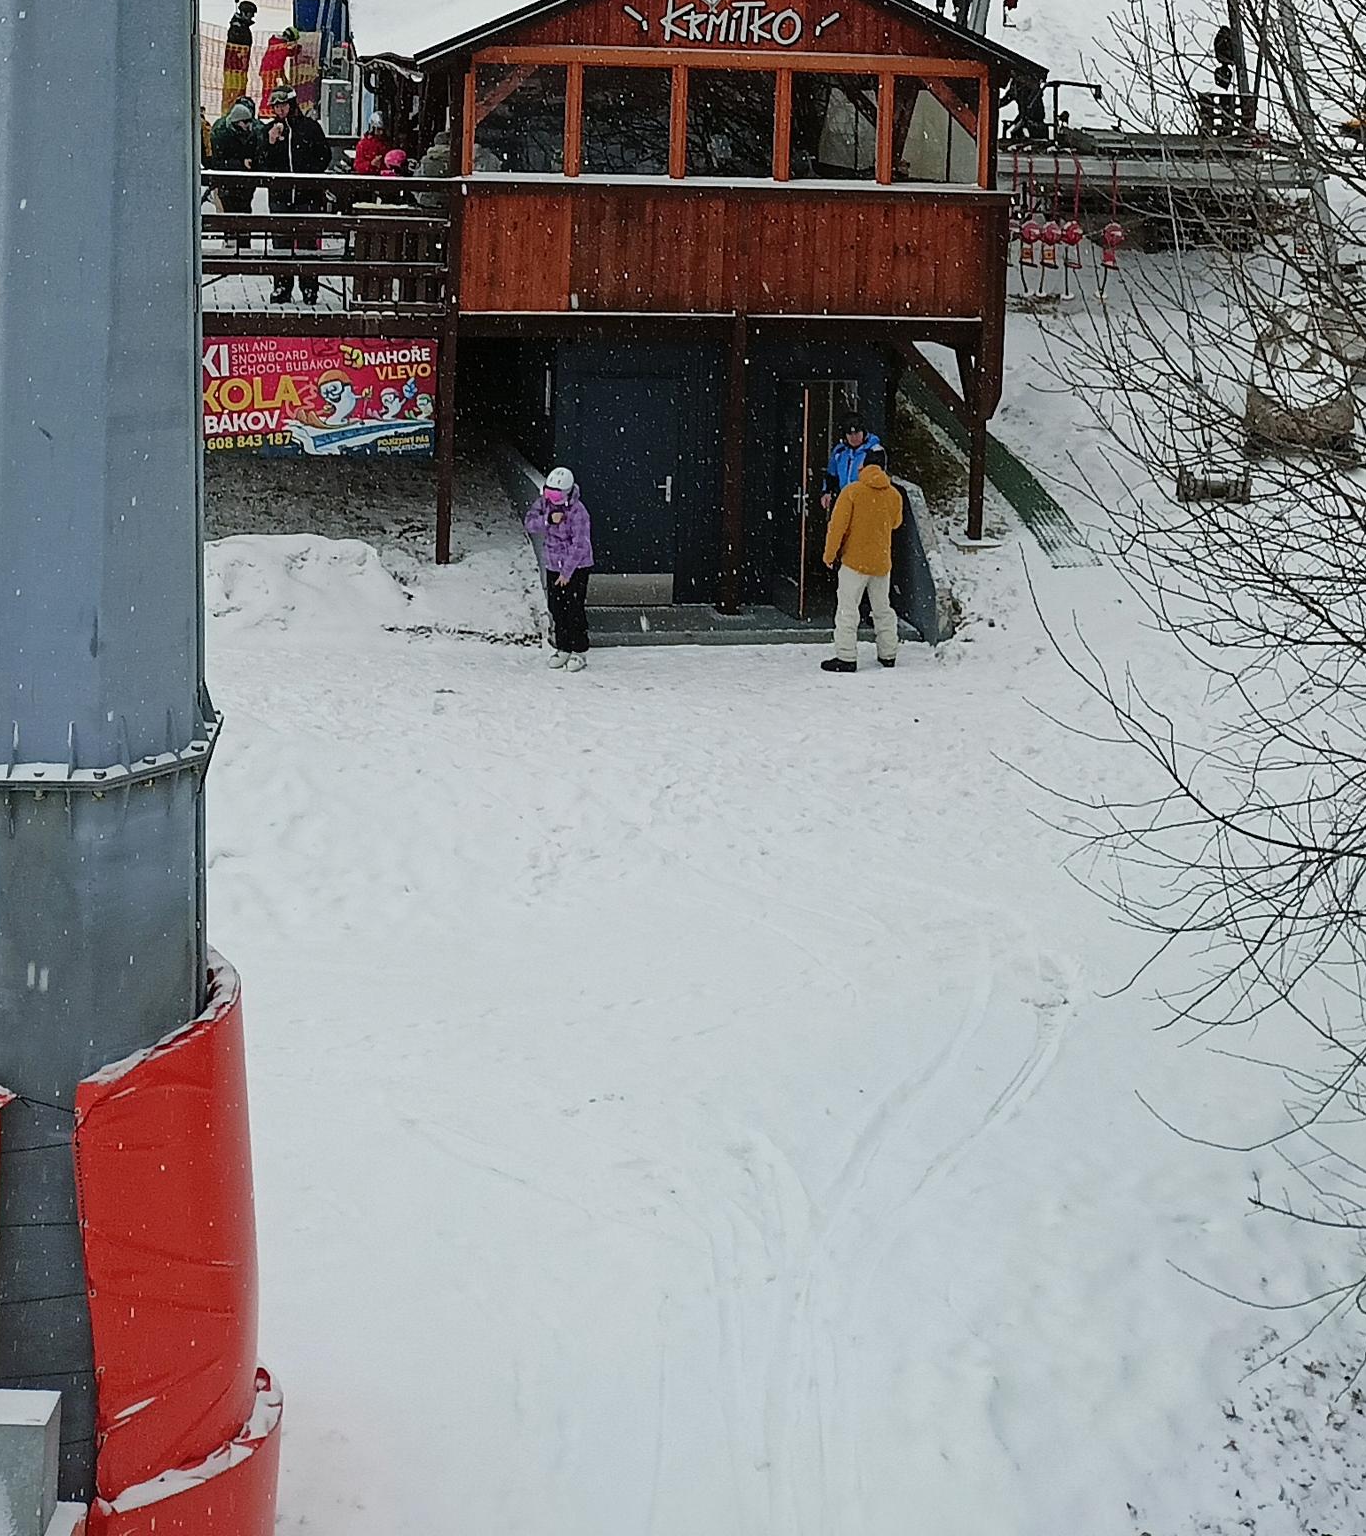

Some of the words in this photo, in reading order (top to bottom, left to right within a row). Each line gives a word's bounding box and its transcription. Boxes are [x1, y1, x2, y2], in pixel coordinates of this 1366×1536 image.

[231, 343, 250, 354] SKI
[252, 341, 277, 352] AND
[363, 346, 431, 366] NAHOŘE
[231, 349, 308, 365] SNOWBOARD
[232, 363, 283, 376] SCHOOL
[375, 363, 432, 381] VLEVO
[207, 436, 234, 450] 608
[237, 434, 263, 448] 843
[266, 432, 292, 446] 187
